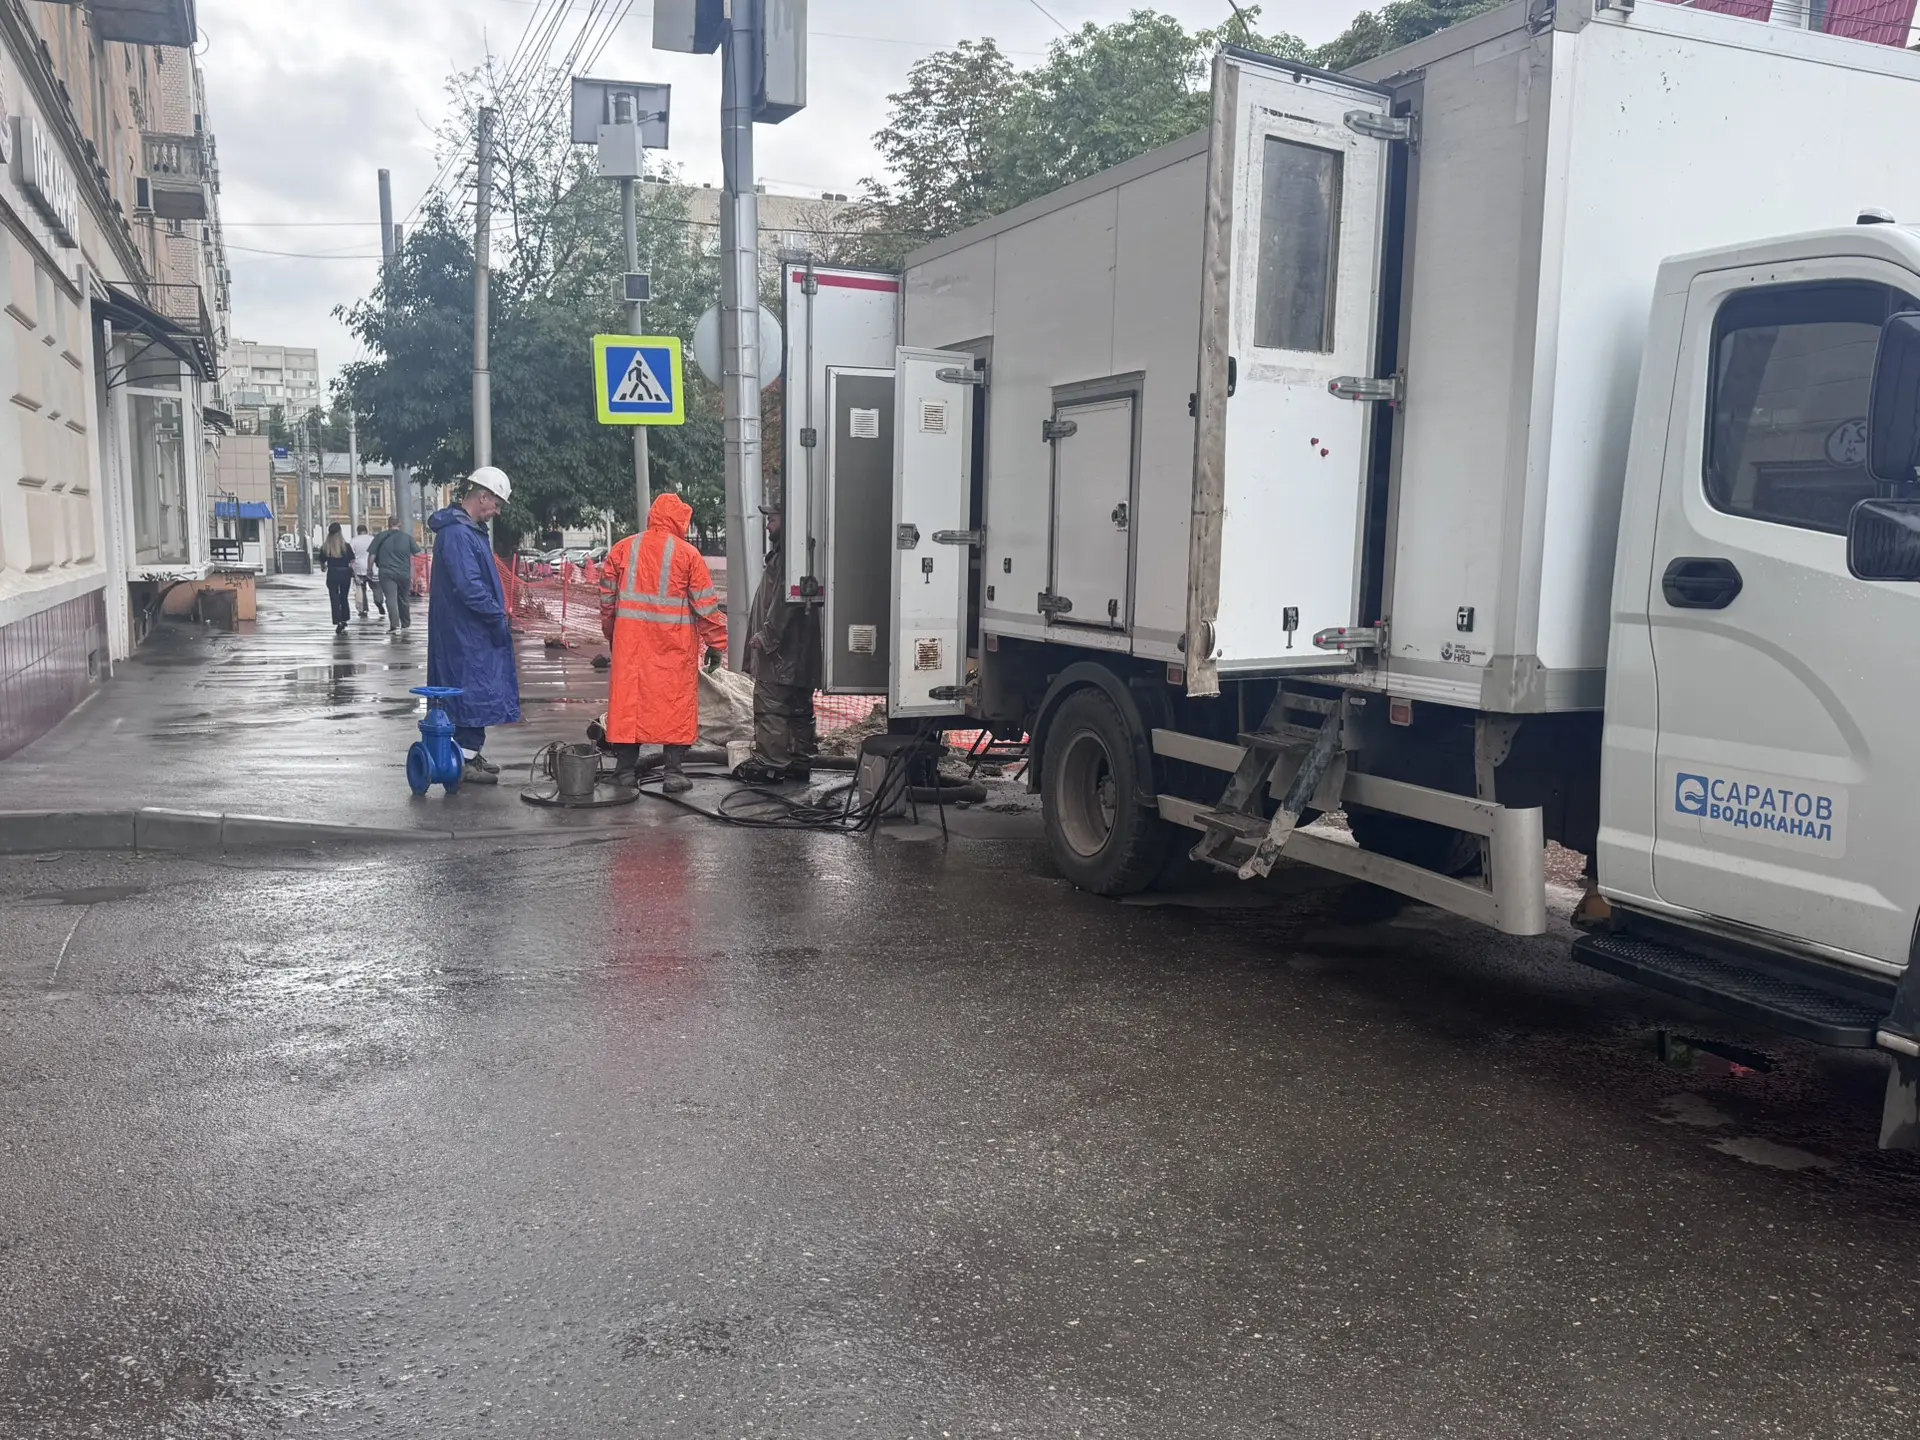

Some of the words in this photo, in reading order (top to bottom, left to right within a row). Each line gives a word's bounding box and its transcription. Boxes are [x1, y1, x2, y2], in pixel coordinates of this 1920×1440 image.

[32, 117, 80, 248] ПЕКАРНЯ
[1710, 779, 1833, 821] САРАТОВ
[1709, 803, 1832, 841] ВОДОКАНАЛ
